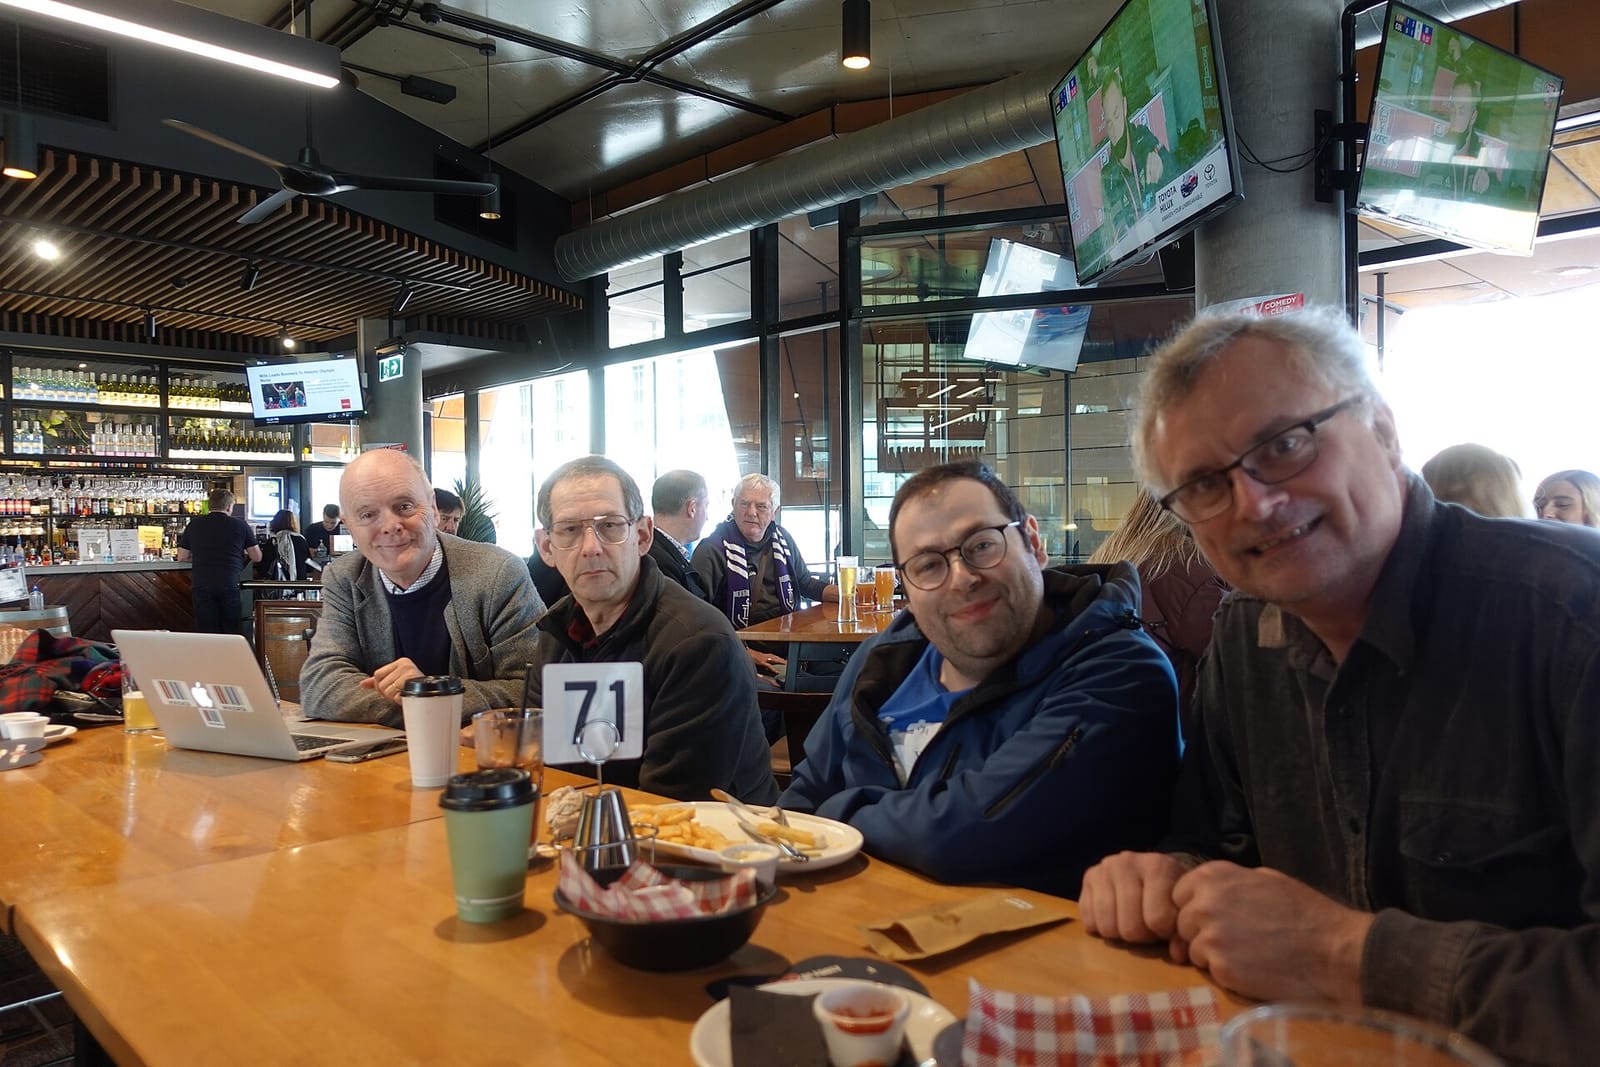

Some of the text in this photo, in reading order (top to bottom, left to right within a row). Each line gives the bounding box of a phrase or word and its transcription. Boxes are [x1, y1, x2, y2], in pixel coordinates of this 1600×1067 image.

[1373, 134, 1388, 145] KFC
[1158, 185, 1178, 204] TOYOTA
[1159, 198, 1174, 214] HILUX
[1264, 296, 1297, 310] COMEDY
[564, 680, 625, 745] 71
